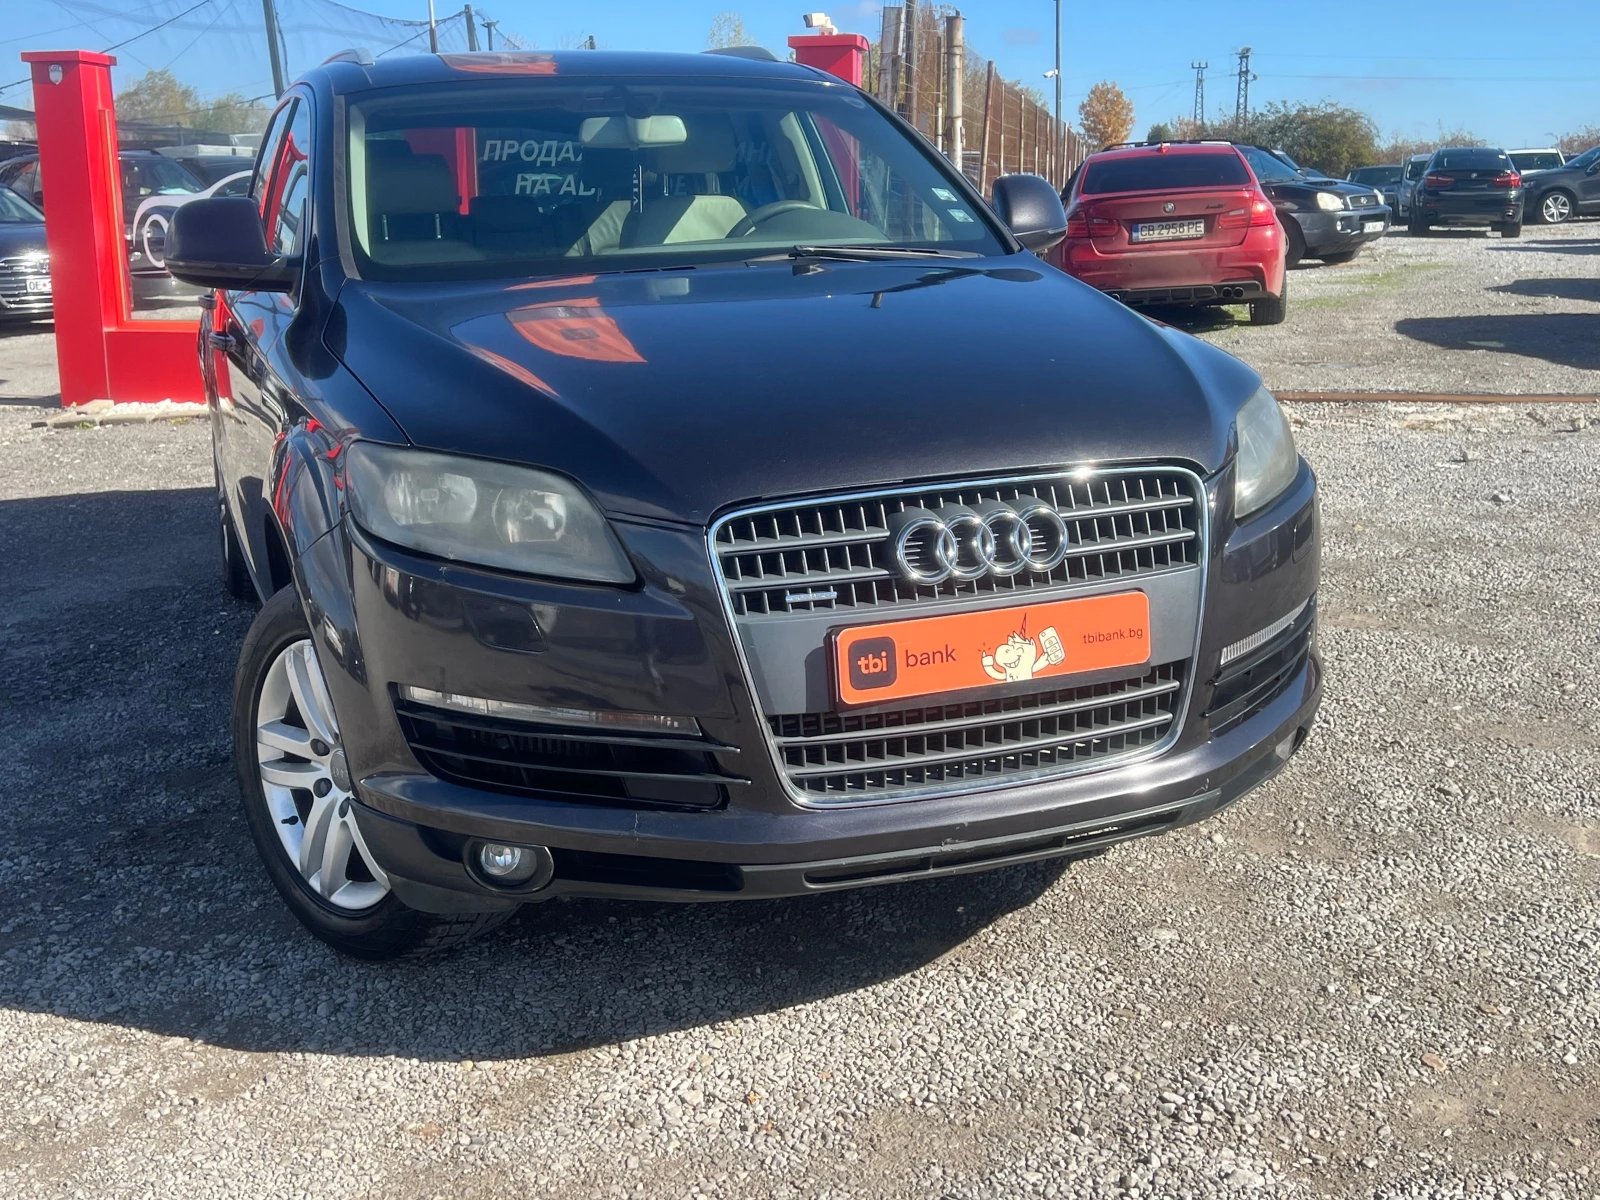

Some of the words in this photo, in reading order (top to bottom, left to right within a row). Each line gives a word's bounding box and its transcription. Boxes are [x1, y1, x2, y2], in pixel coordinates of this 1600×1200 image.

[482, 139, 583, 167] ПРОДА
[514, 172, 551, 195] НА
[1140, 225, 1155, 237] CB
[1157, 222, 1185, 235] 2958
[1187, 220, 1203, 233] PE
[1082, 627, 1144, 645] tbibank.bg
[857, 650, 888, 675] tbi
[905, 644, 957, 668] bank
